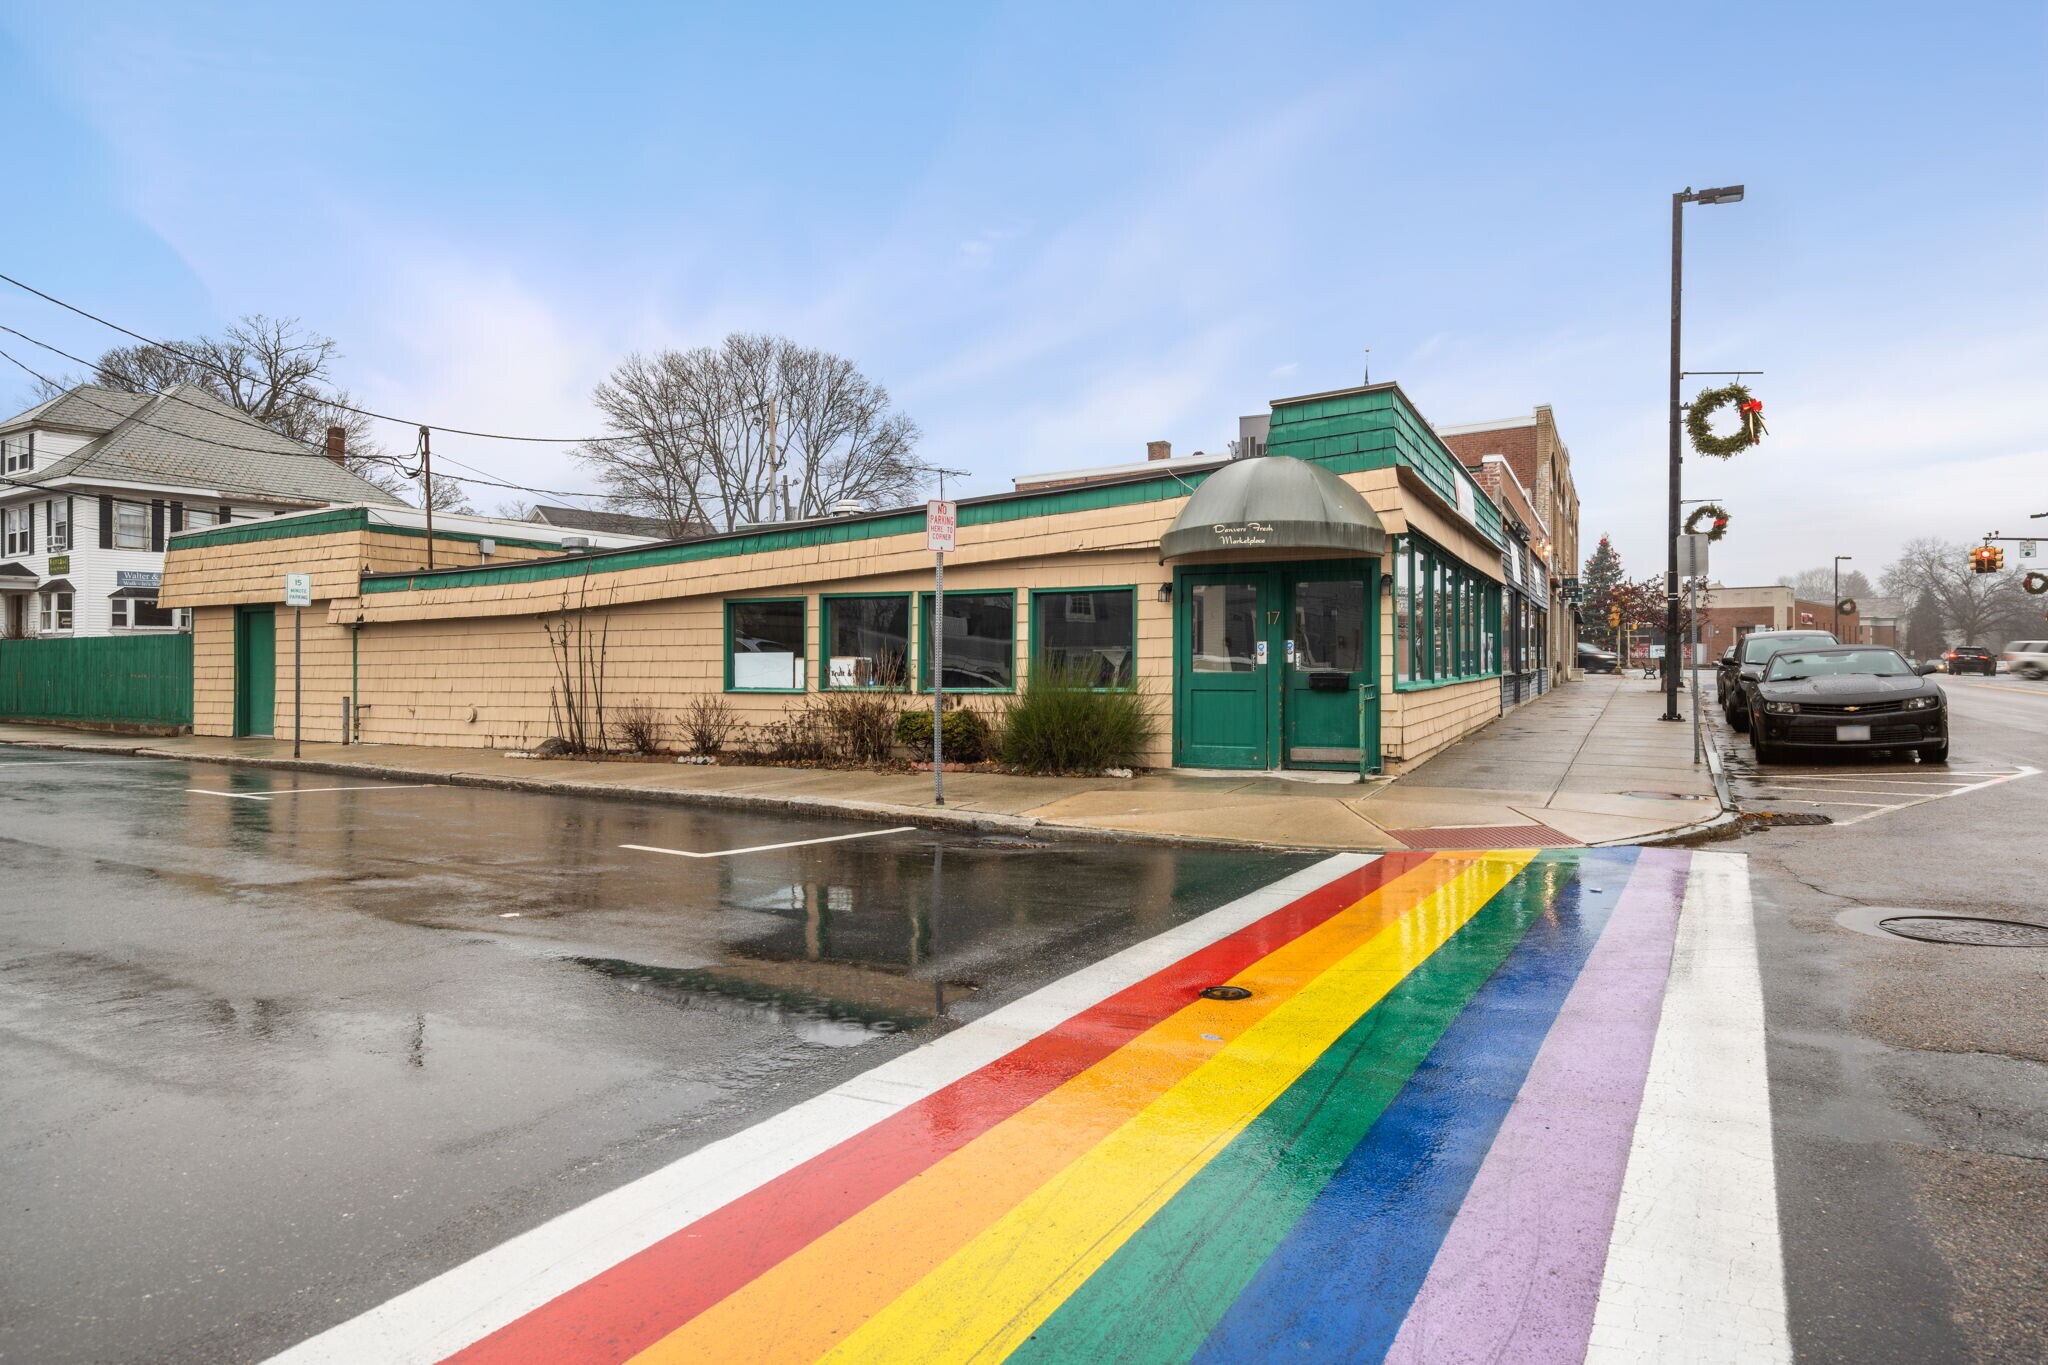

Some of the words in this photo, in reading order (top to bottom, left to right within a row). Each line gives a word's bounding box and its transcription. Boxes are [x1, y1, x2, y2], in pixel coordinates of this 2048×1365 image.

[937, 505, 947, 514] NO
[930, 514, 954, 526] PARKING
[930, 525, 944, 533] HERE
[947, 526, 954, 534] TO
[1248, 522, 1274, 532] Fresh
[1219, 535, 1266, 546] Marketplace
[124, 571, 150, 580] Walter
[1266, 611, 1280, 625] 17
